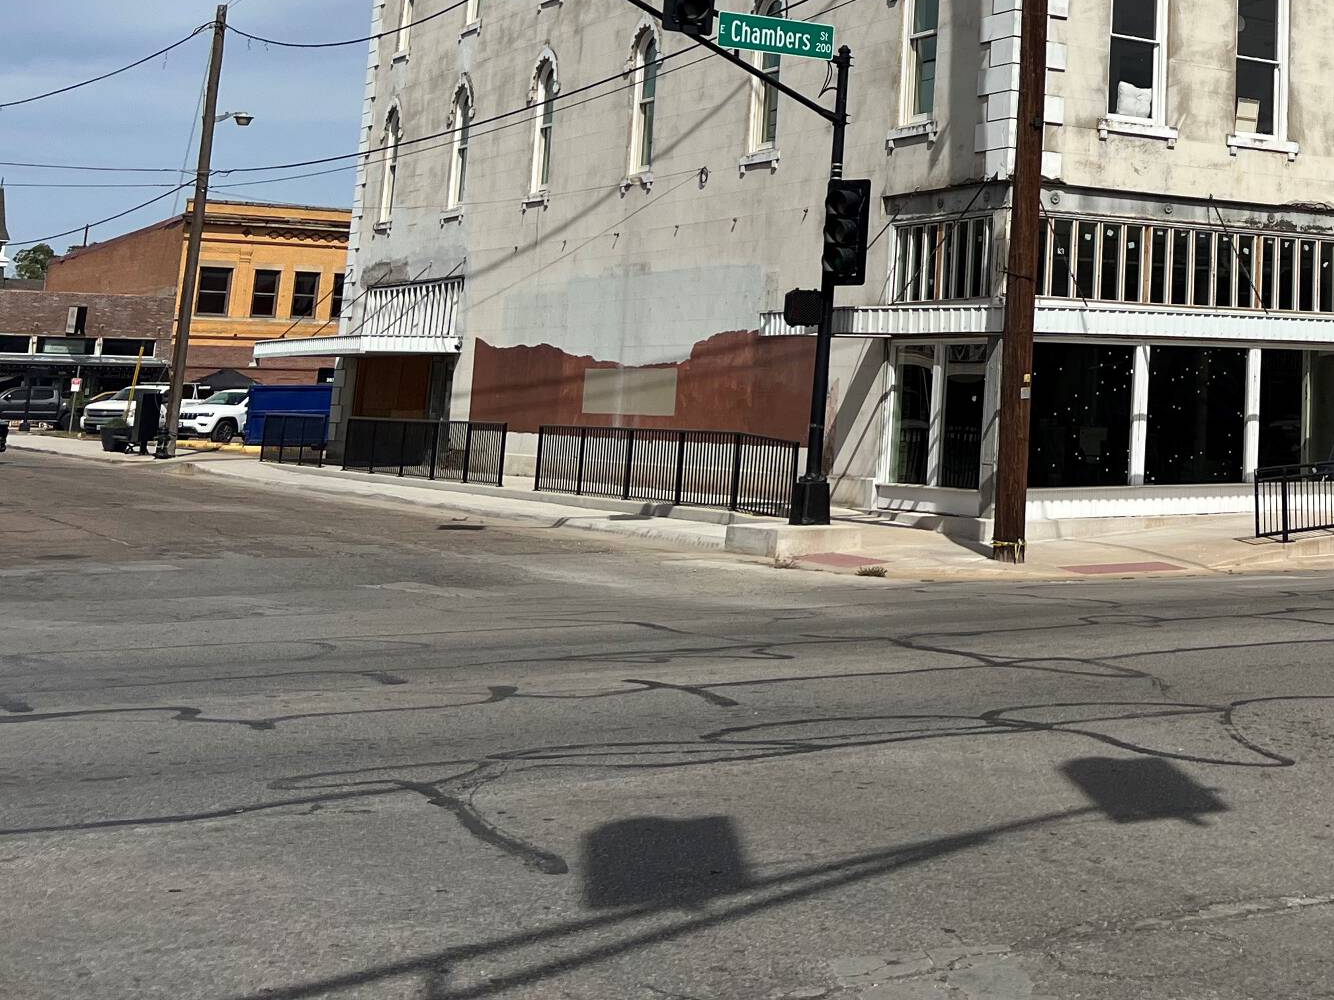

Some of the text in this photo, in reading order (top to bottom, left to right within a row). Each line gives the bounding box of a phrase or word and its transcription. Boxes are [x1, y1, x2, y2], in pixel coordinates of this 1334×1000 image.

[720, 20, 829, 51] E Chambers St
[815, 42, 832, 54] 200
